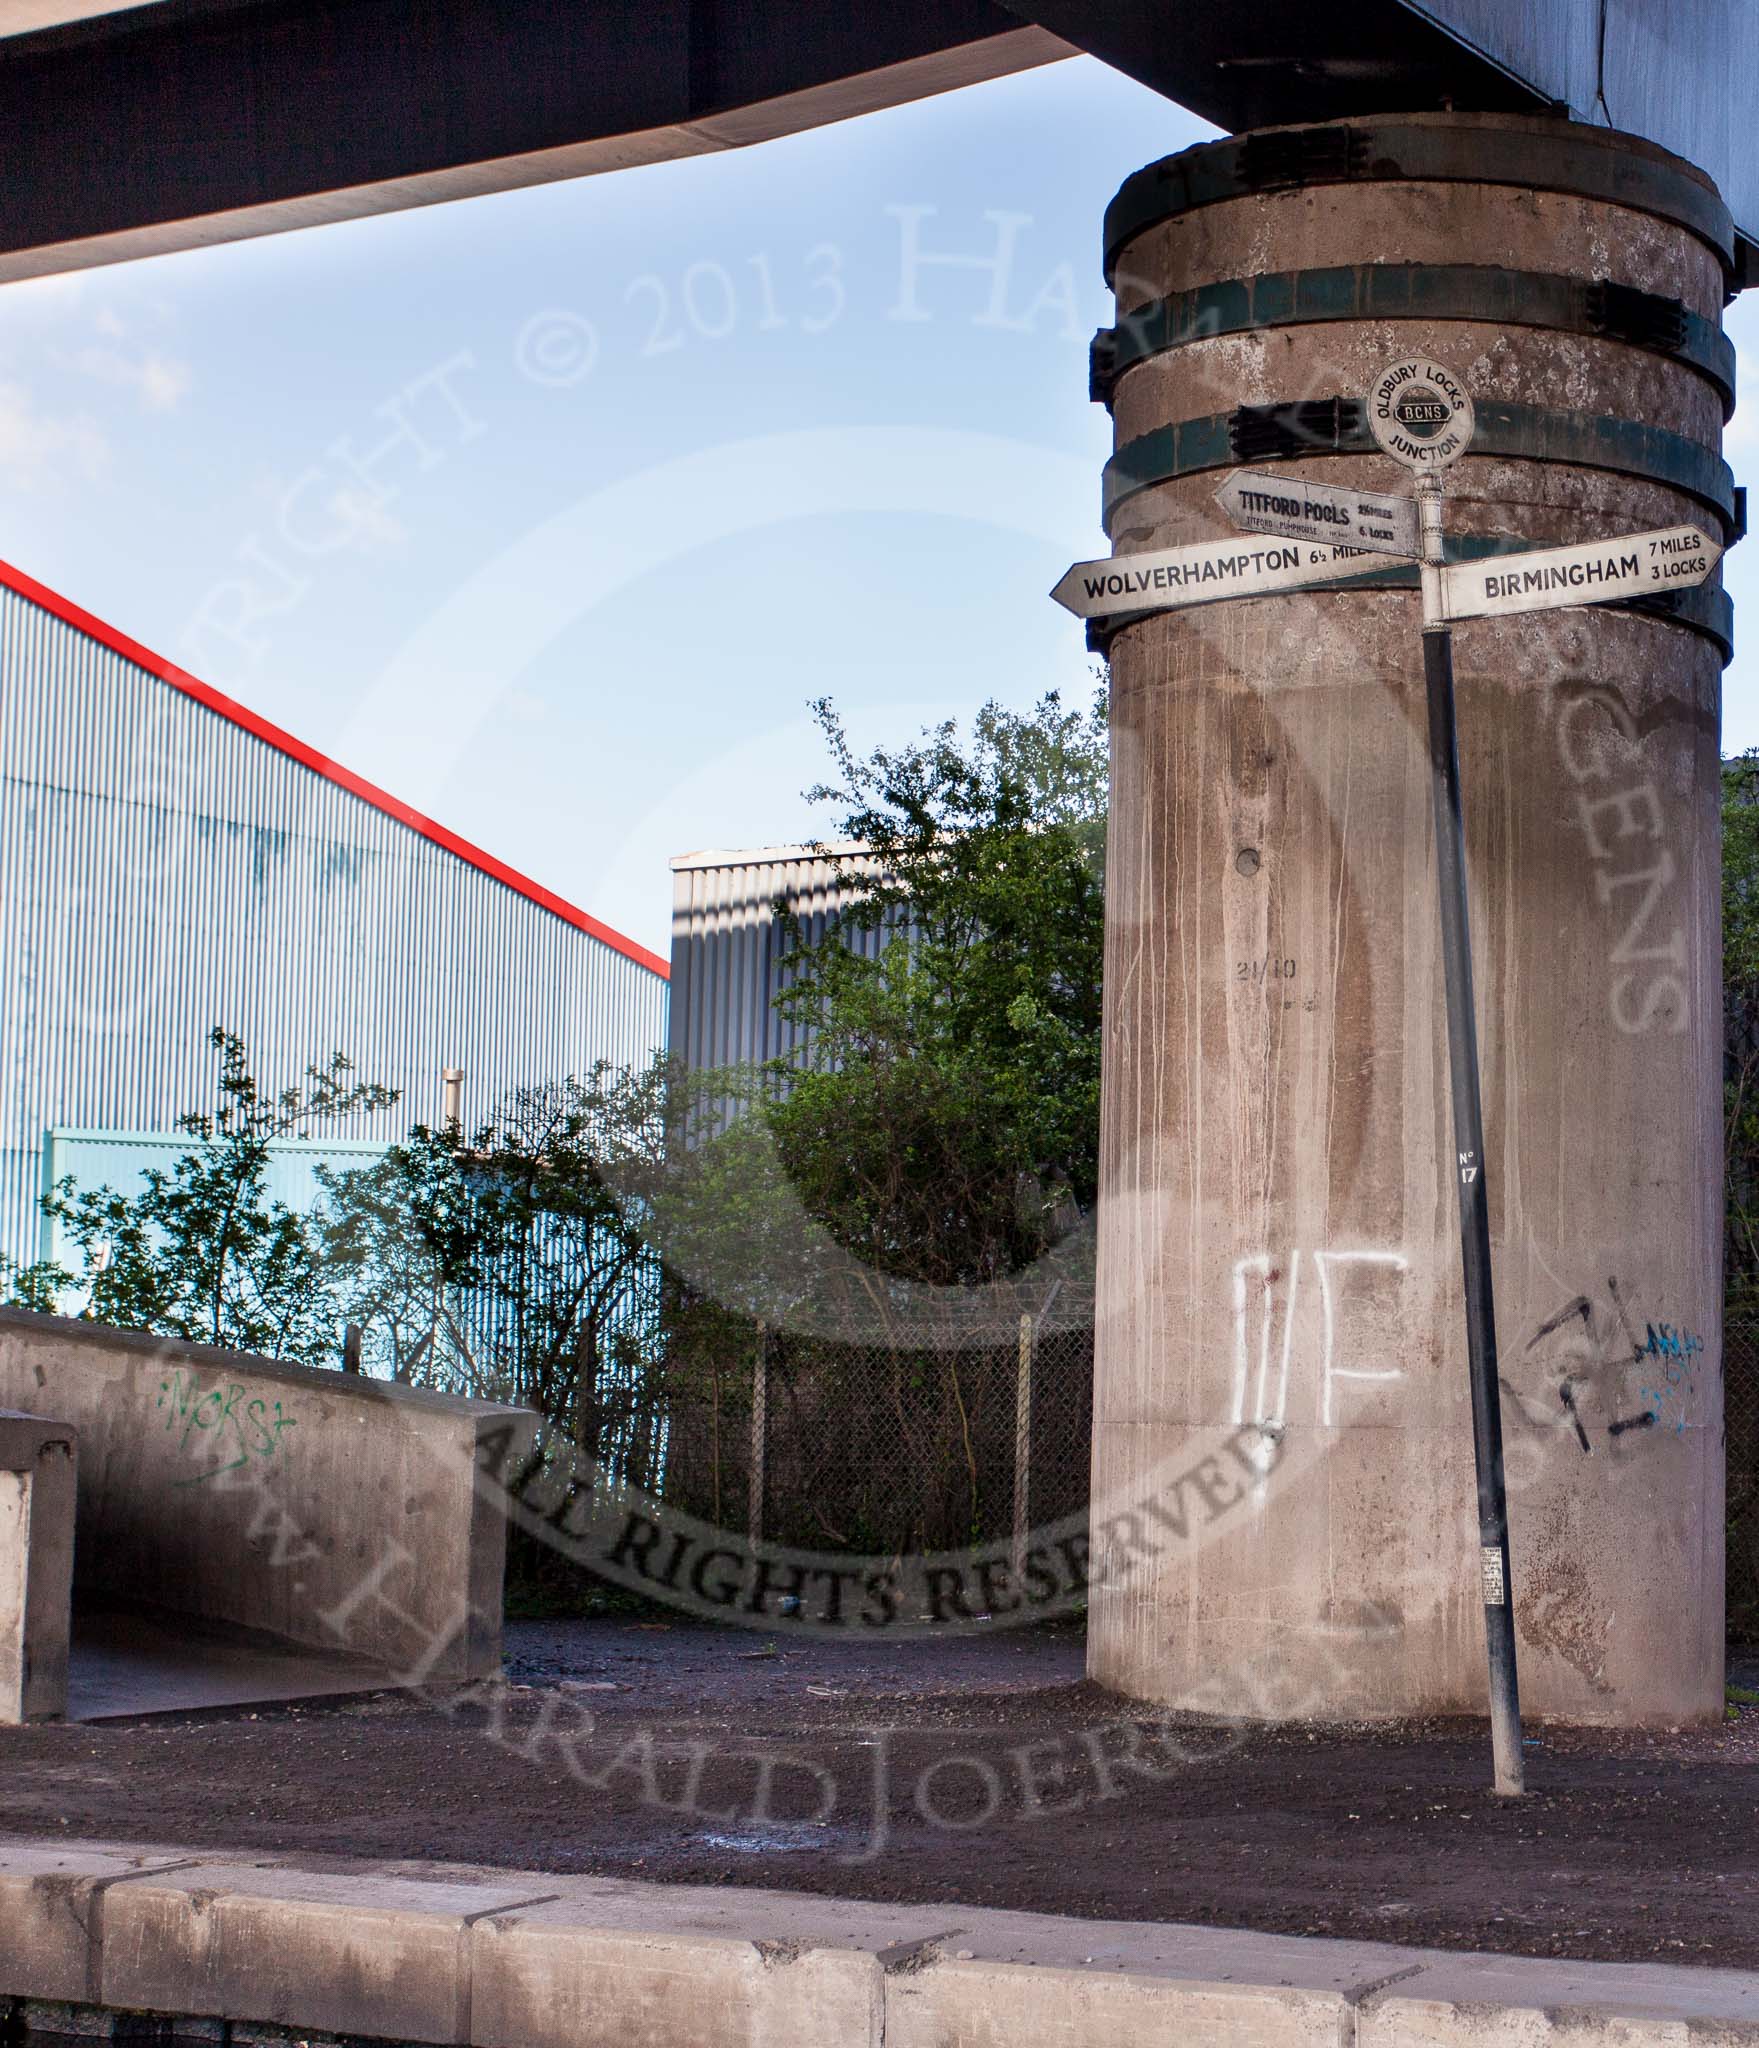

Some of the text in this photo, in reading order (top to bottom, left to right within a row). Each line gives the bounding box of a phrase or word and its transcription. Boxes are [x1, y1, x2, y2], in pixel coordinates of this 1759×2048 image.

[1377, 364, 1464, 418] OLDBURY LOCKS
[1405, 406, 1441, 419] BCNS
[1389, 433, 1460, 460] JUNCTION
[1239, 490, 1350, 525] TITFORD POOLS
[1649, 535, 1701, 557] 7 MILES
[1084, 547, 1300, 599] WOLVERHAMPTON
[1333, 546, 1374, 560] MILE
[1485, 554, 1639, 599] BIRMINGHAM
[1652, 557, 1706, 580] 3 LOCKS
[1462, 1167, 1478, 1183] 17
